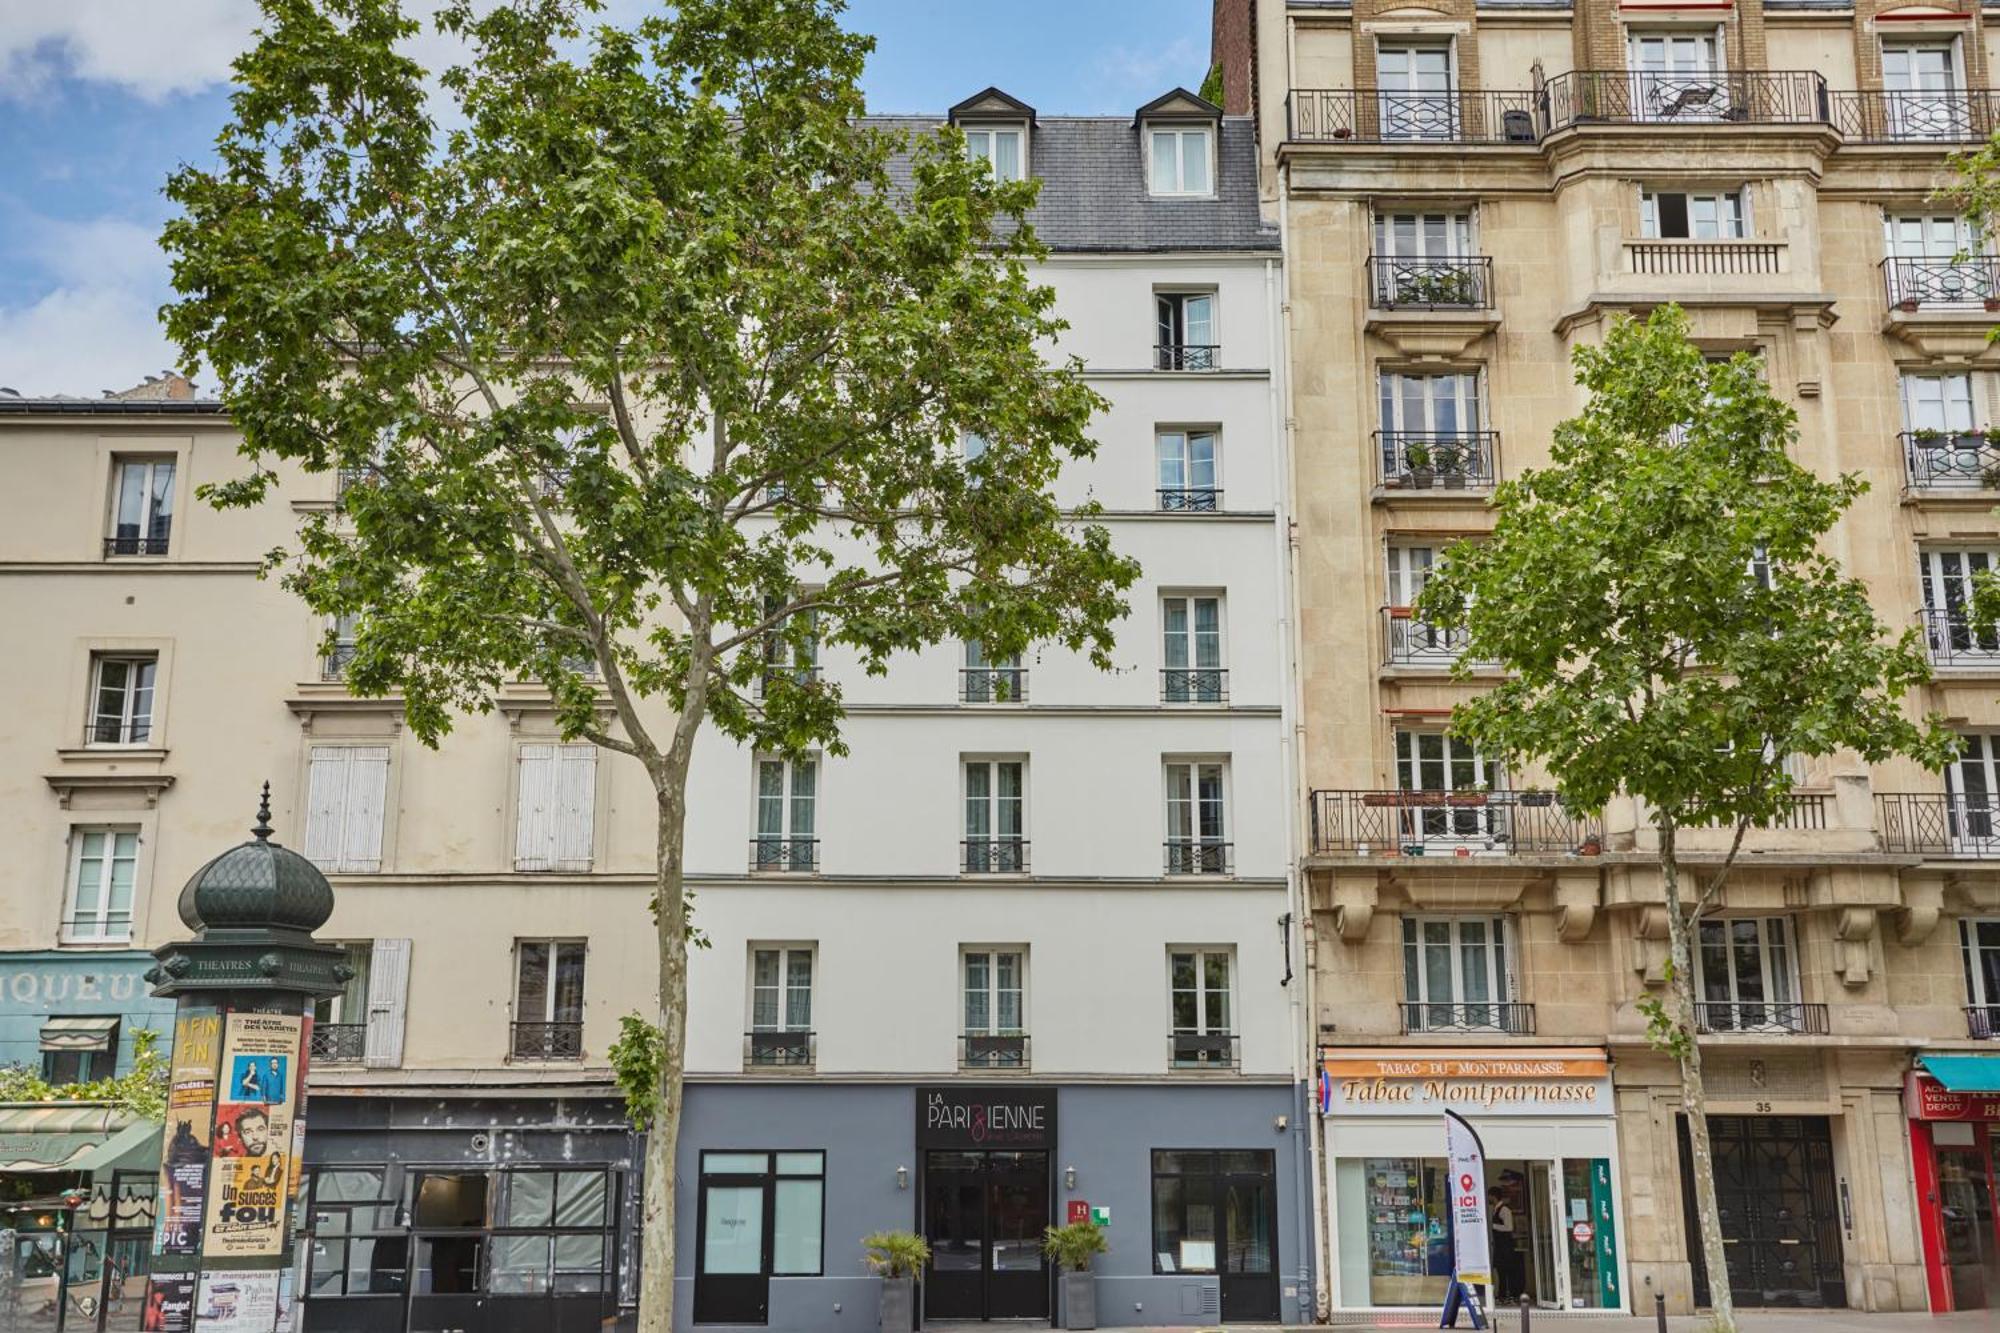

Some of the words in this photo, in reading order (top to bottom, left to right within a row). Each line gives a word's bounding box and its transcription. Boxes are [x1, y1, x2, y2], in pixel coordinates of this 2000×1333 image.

[1377, 1062, 1420, 1074] TABAC
[1431, 1063, 1448, 1074] DU
[1459, 1062, 1565, 1074] MONTPARNASSE
[1342, 1077, 1415, 1102] Tabac
[1422, 1080, 1597, 1108] Montparnasse
[928, 1093, 943, 1105] LA
[1756, 1102, 1771, 1112] 35
[222, 1184, 237, 1201] Un
[1460, 1196, 1477, 1207] ICI
[220, 1202, 275, 1223] fou
[1077, 1205, 1087, 1215] H
